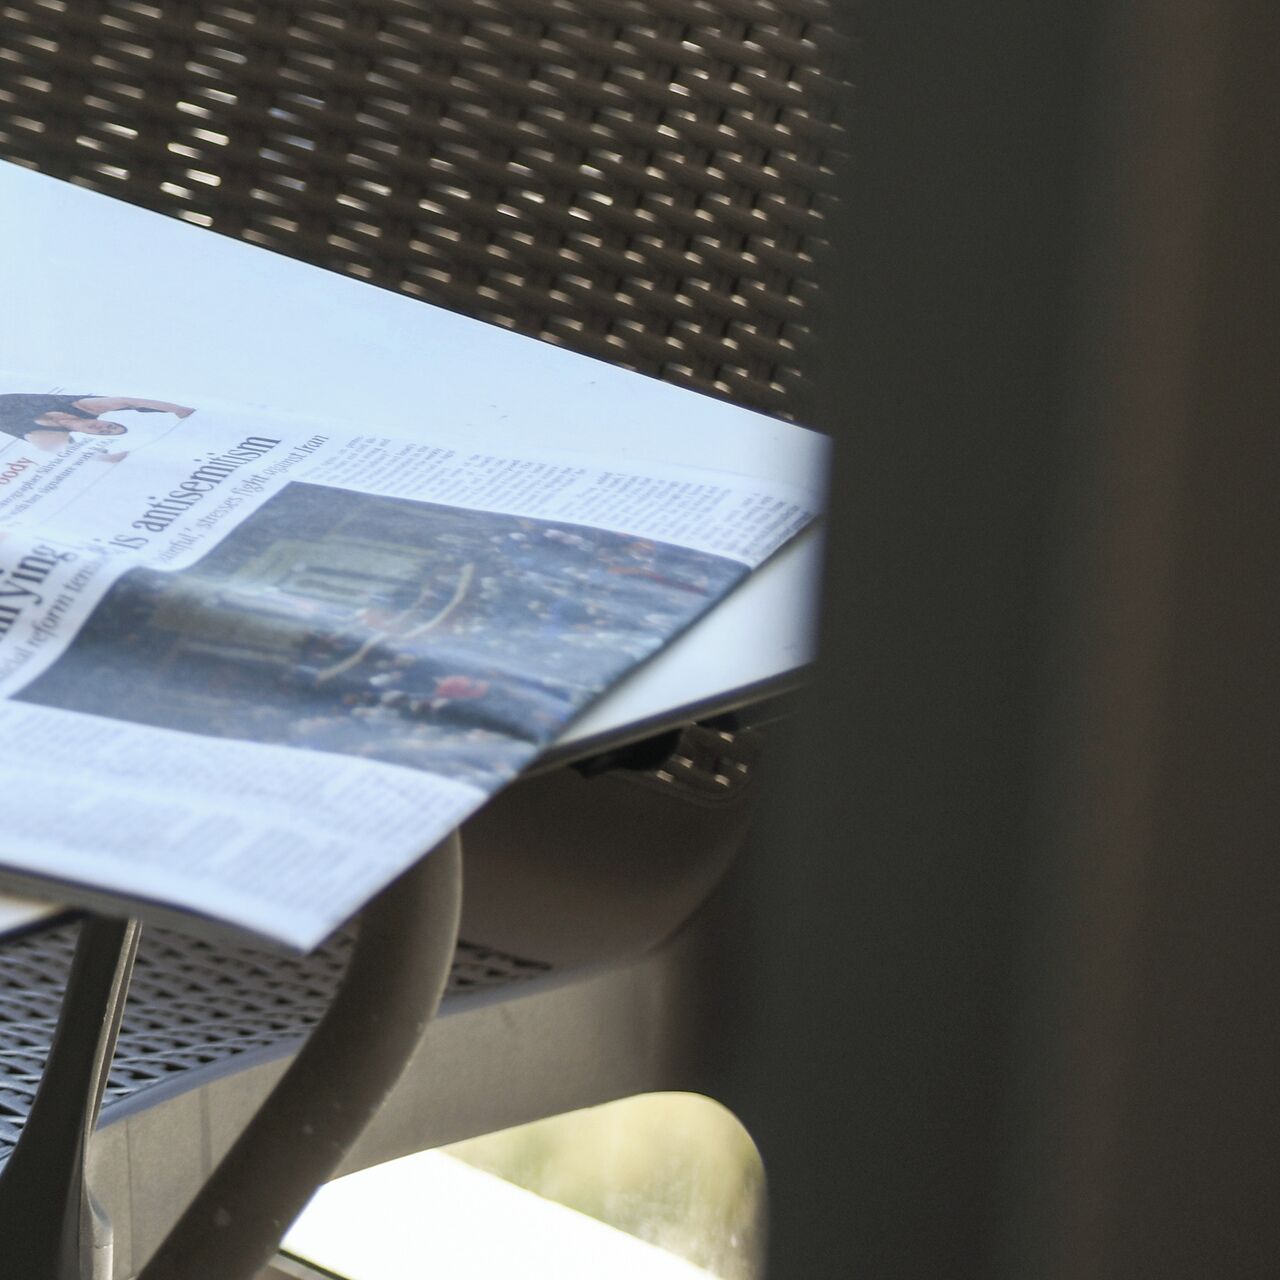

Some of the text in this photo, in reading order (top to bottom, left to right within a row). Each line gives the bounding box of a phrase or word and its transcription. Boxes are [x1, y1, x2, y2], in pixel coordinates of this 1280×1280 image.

[27, 592, 76, 649] reform
[230, 474, 266, 498] fight
[293, 433, 330, 455] Iran
[95, 518, 150, 551] is
[131, 435, 282, 533] antisemitism
